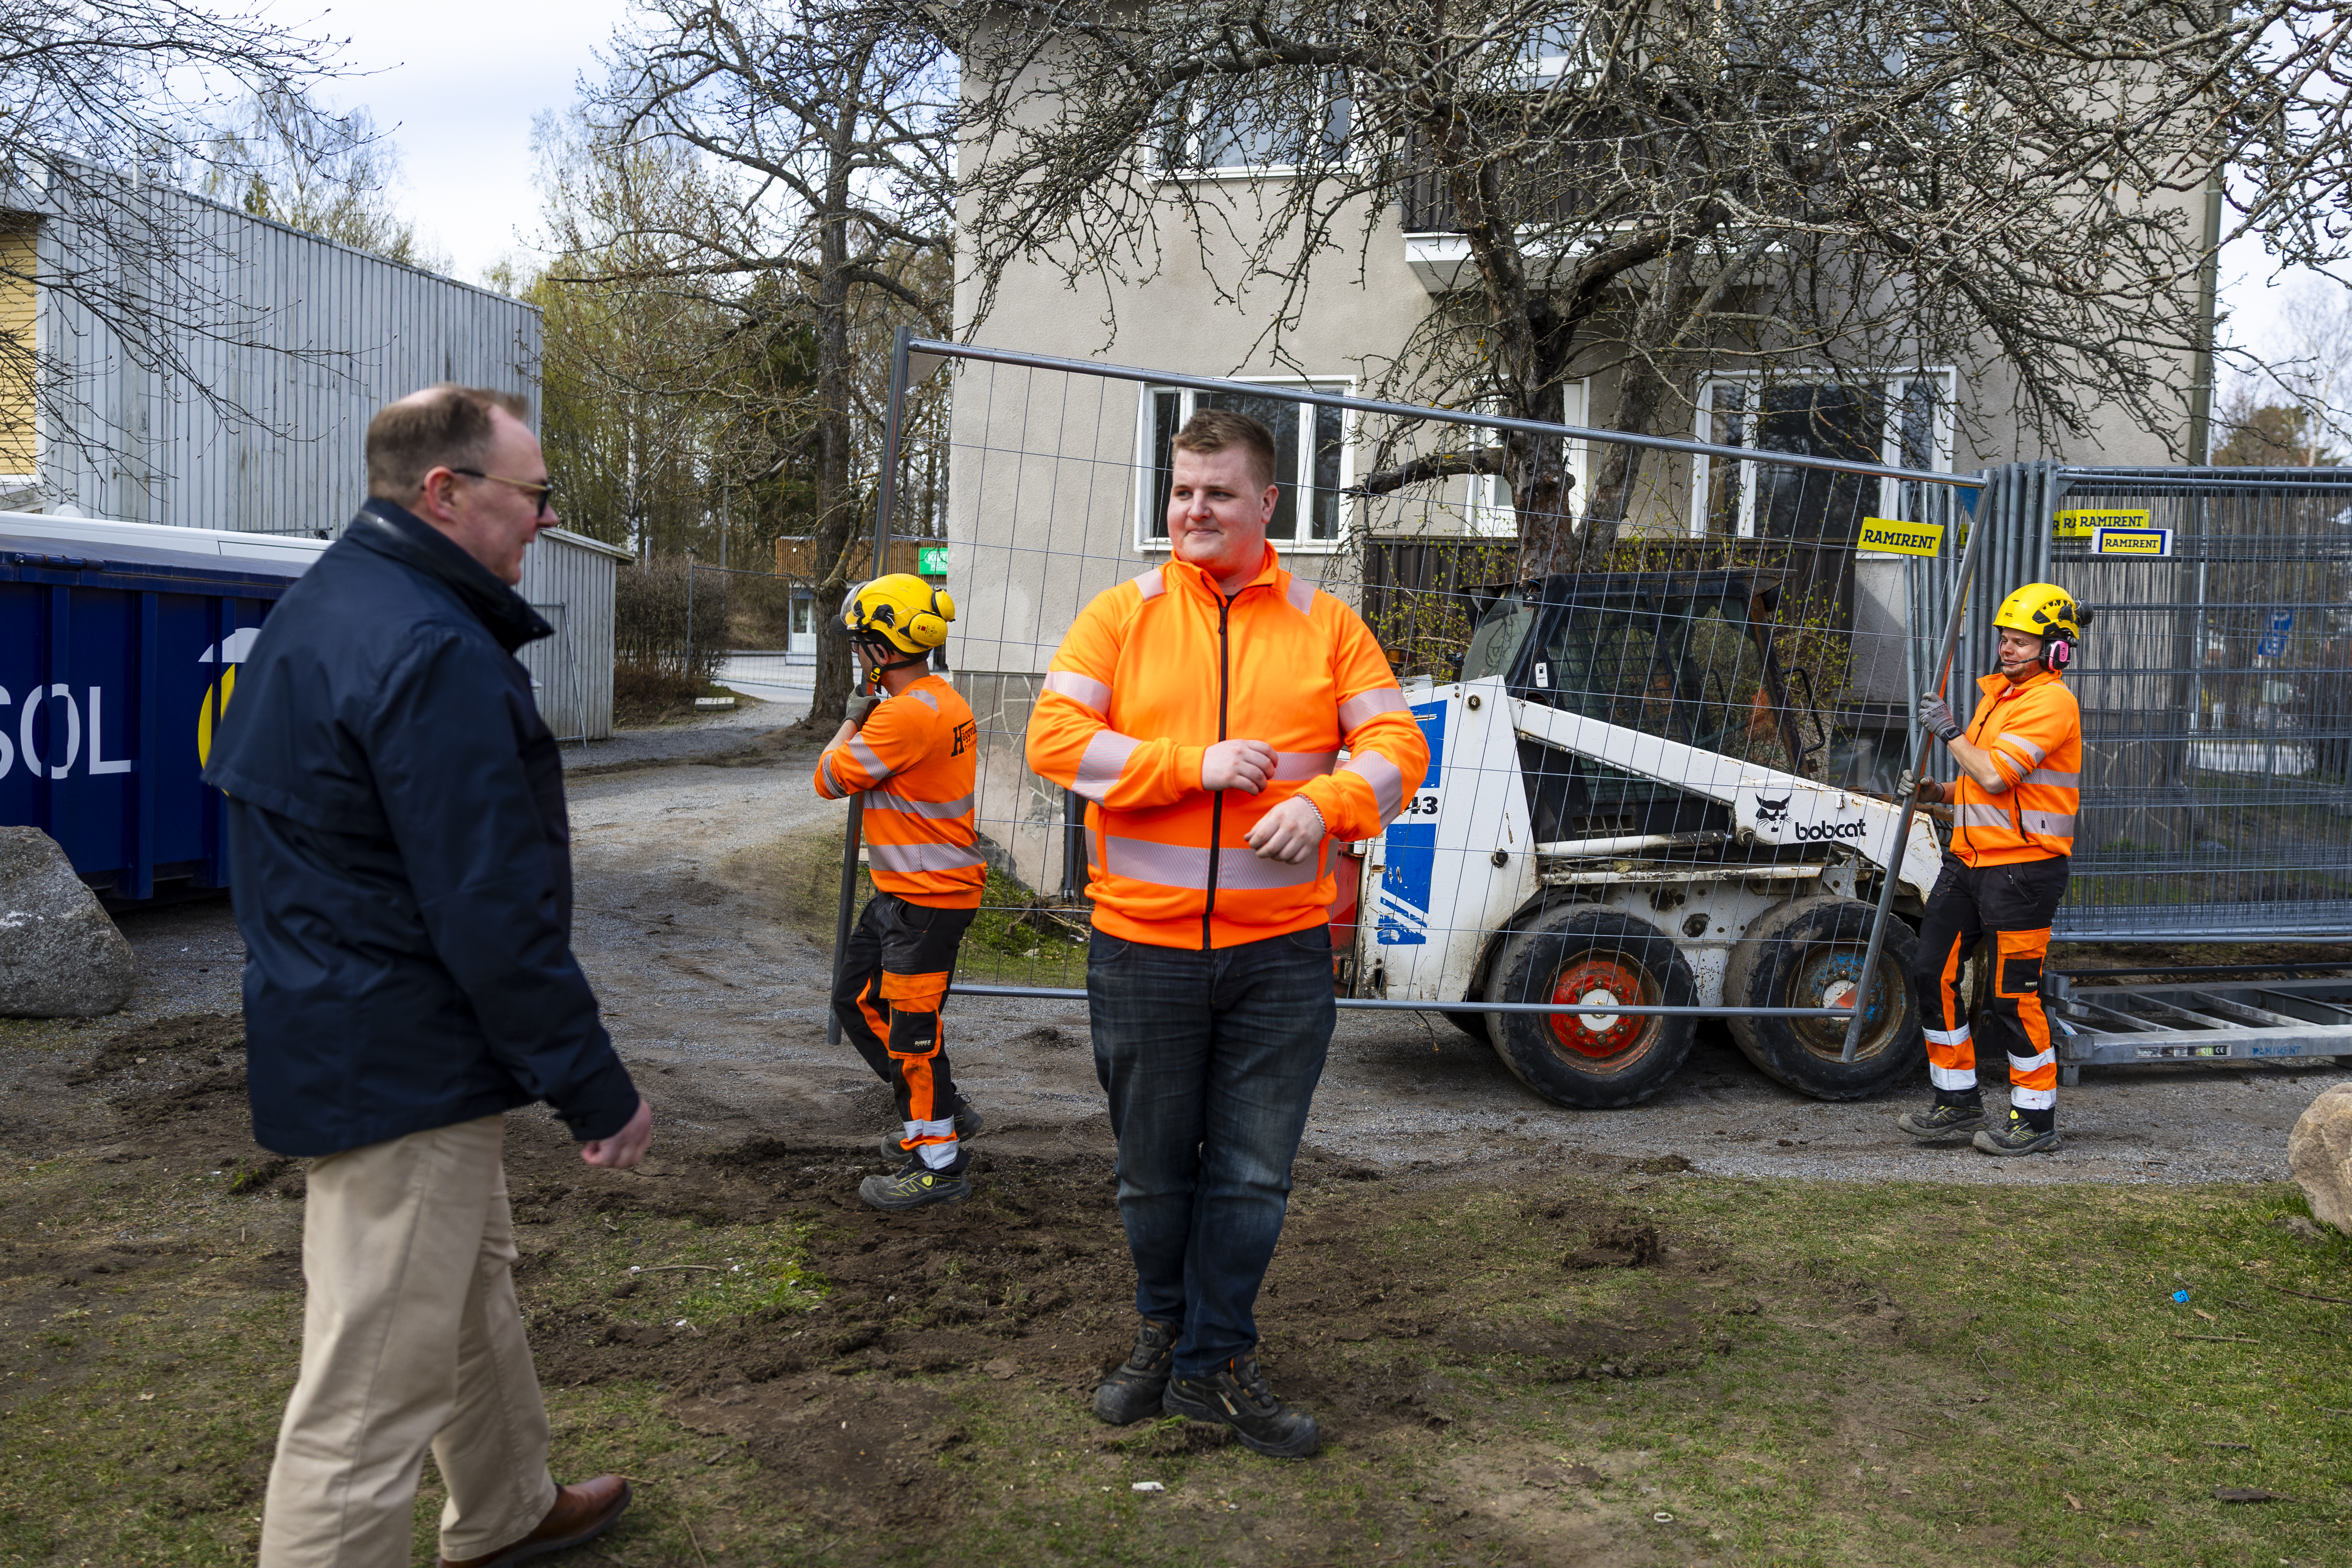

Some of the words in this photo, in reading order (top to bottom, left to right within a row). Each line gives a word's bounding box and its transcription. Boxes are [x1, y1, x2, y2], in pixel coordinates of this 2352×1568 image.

[2080, 516, 2143, 527] RAMIRENT
[1863, 525, 1936, 549] RAMIRENT
[2105, 538, 2158, 548] RAMIRENT
[1795, 818, 1866, 841] bobcat
